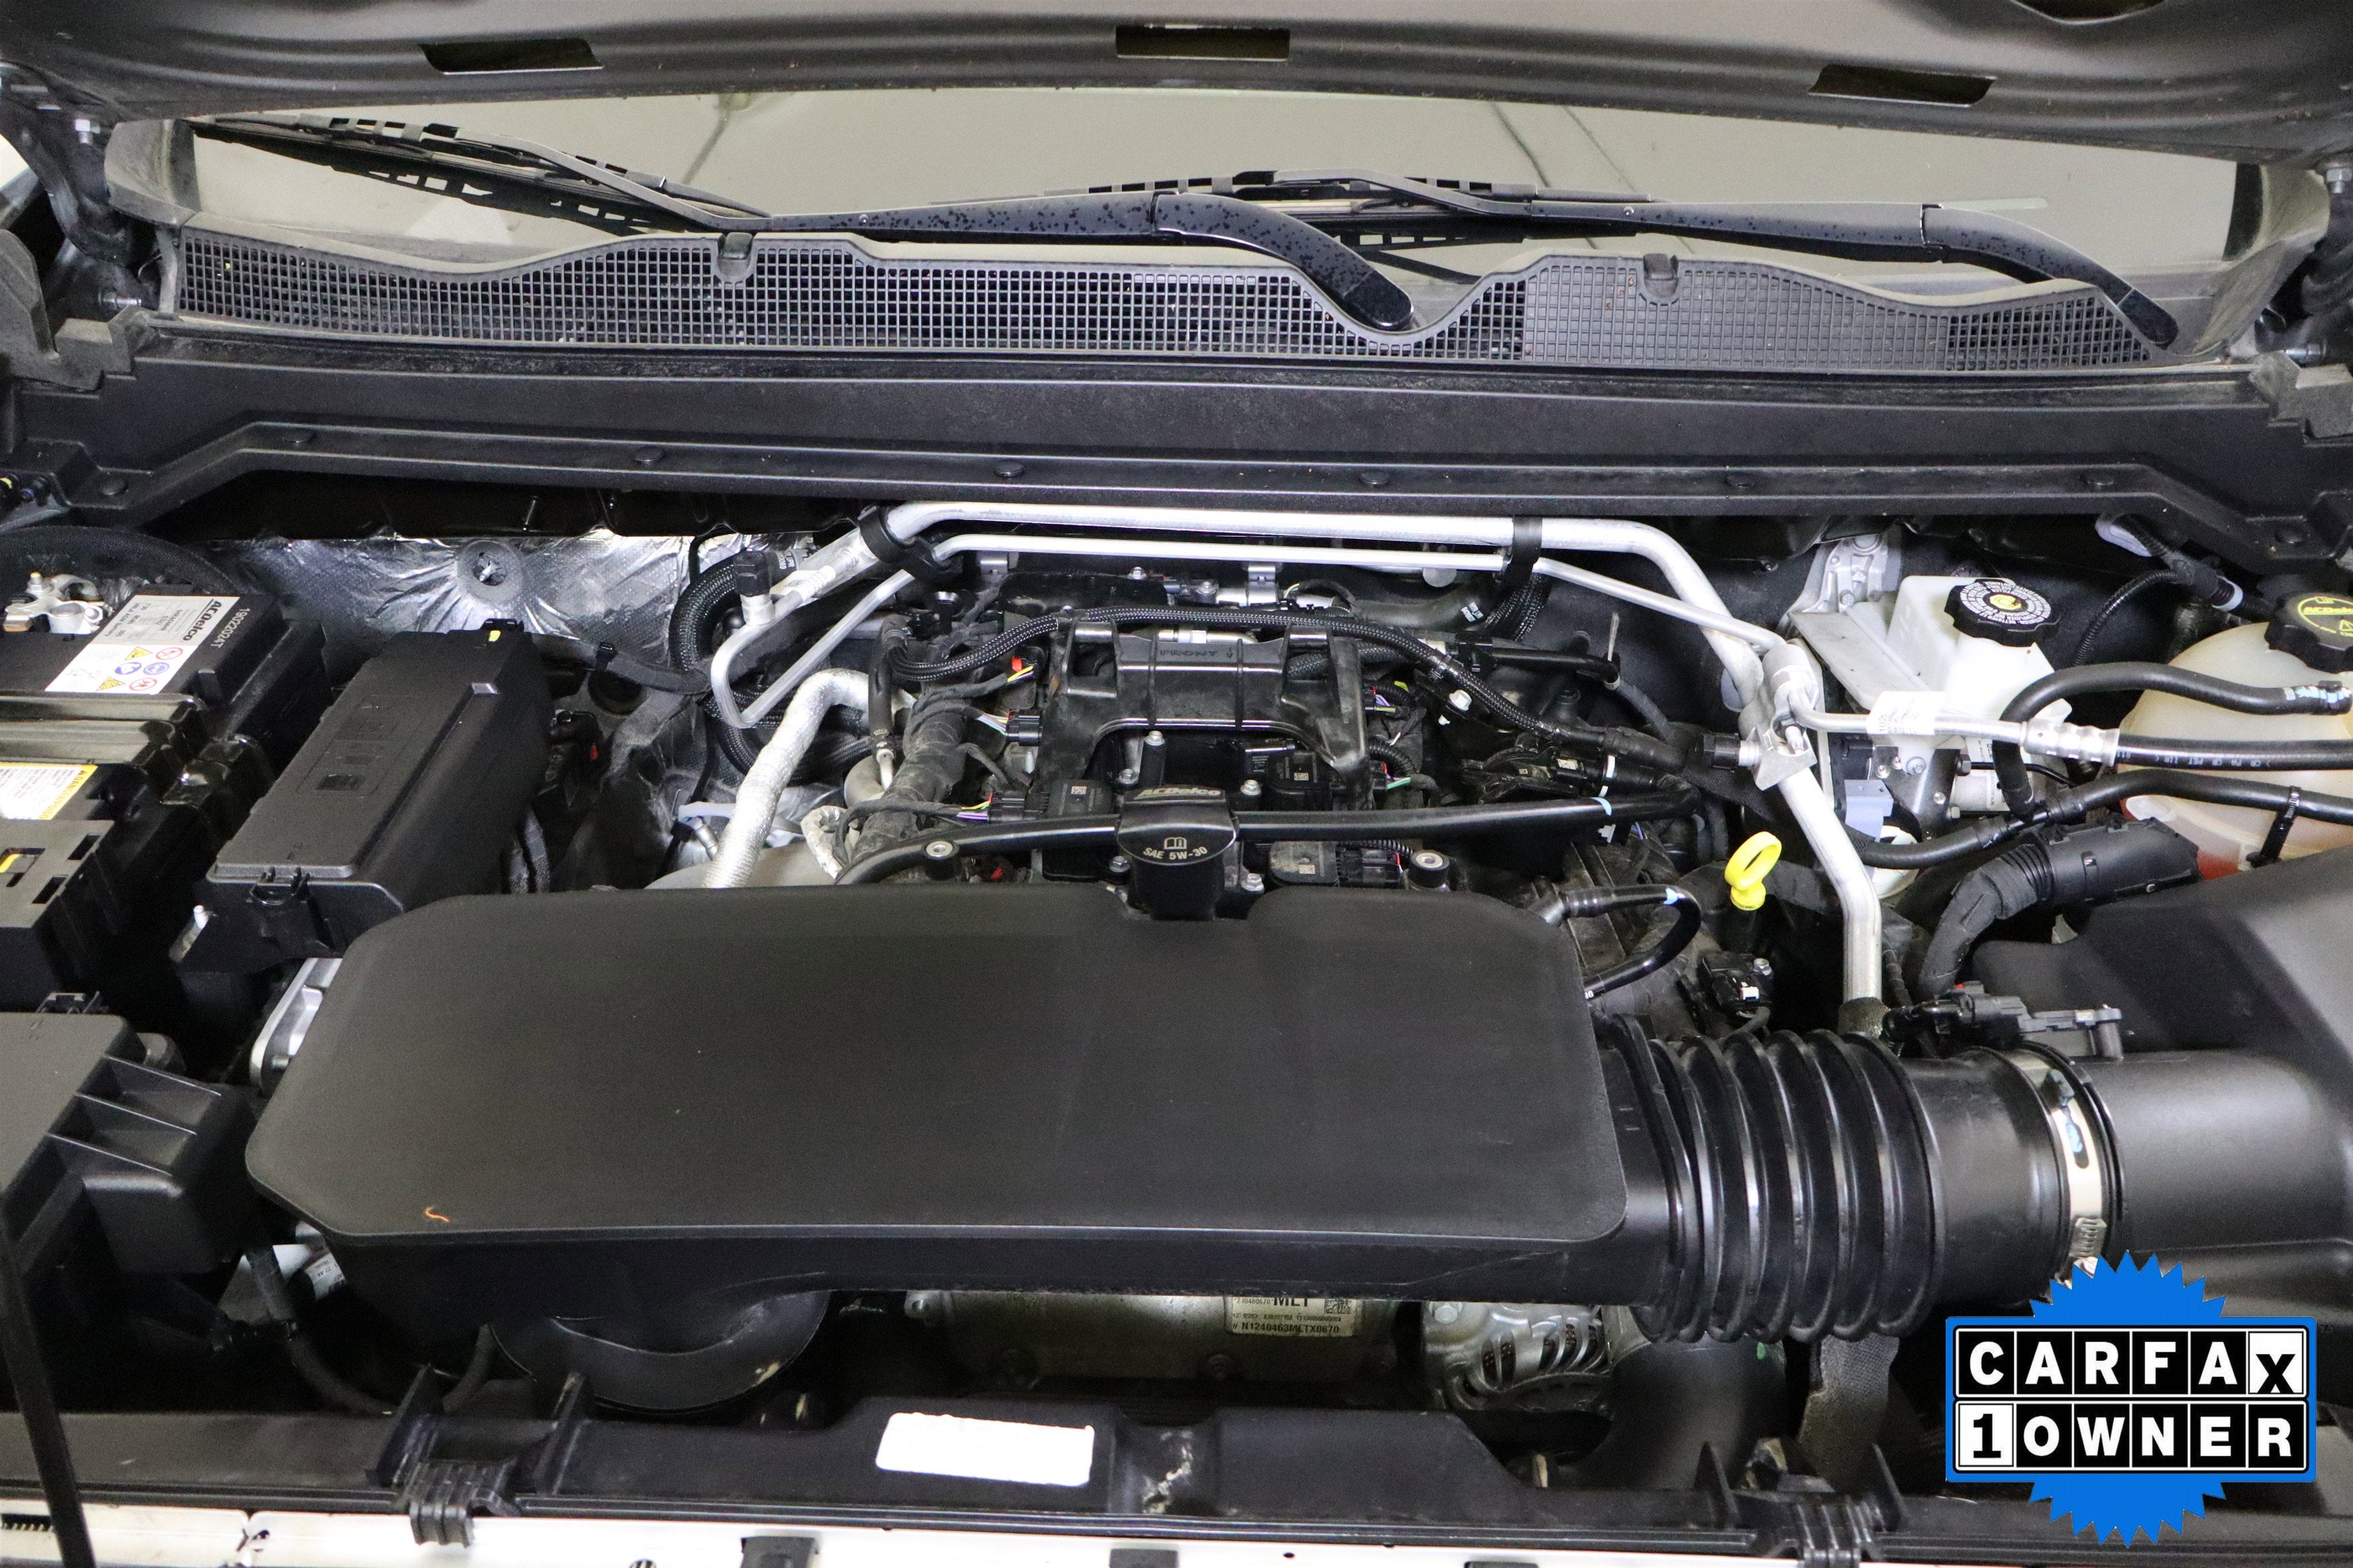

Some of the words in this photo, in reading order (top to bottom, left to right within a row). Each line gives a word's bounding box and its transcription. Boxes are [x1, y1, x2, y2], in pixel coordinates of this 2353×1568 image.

[183, 600, 222, 641] ACDelco
[1136, 787, 1221, 798] ACDelco
[1143, 848, 1164, 859] SAE
[1169, 846, 1208, 860] 5W-30
